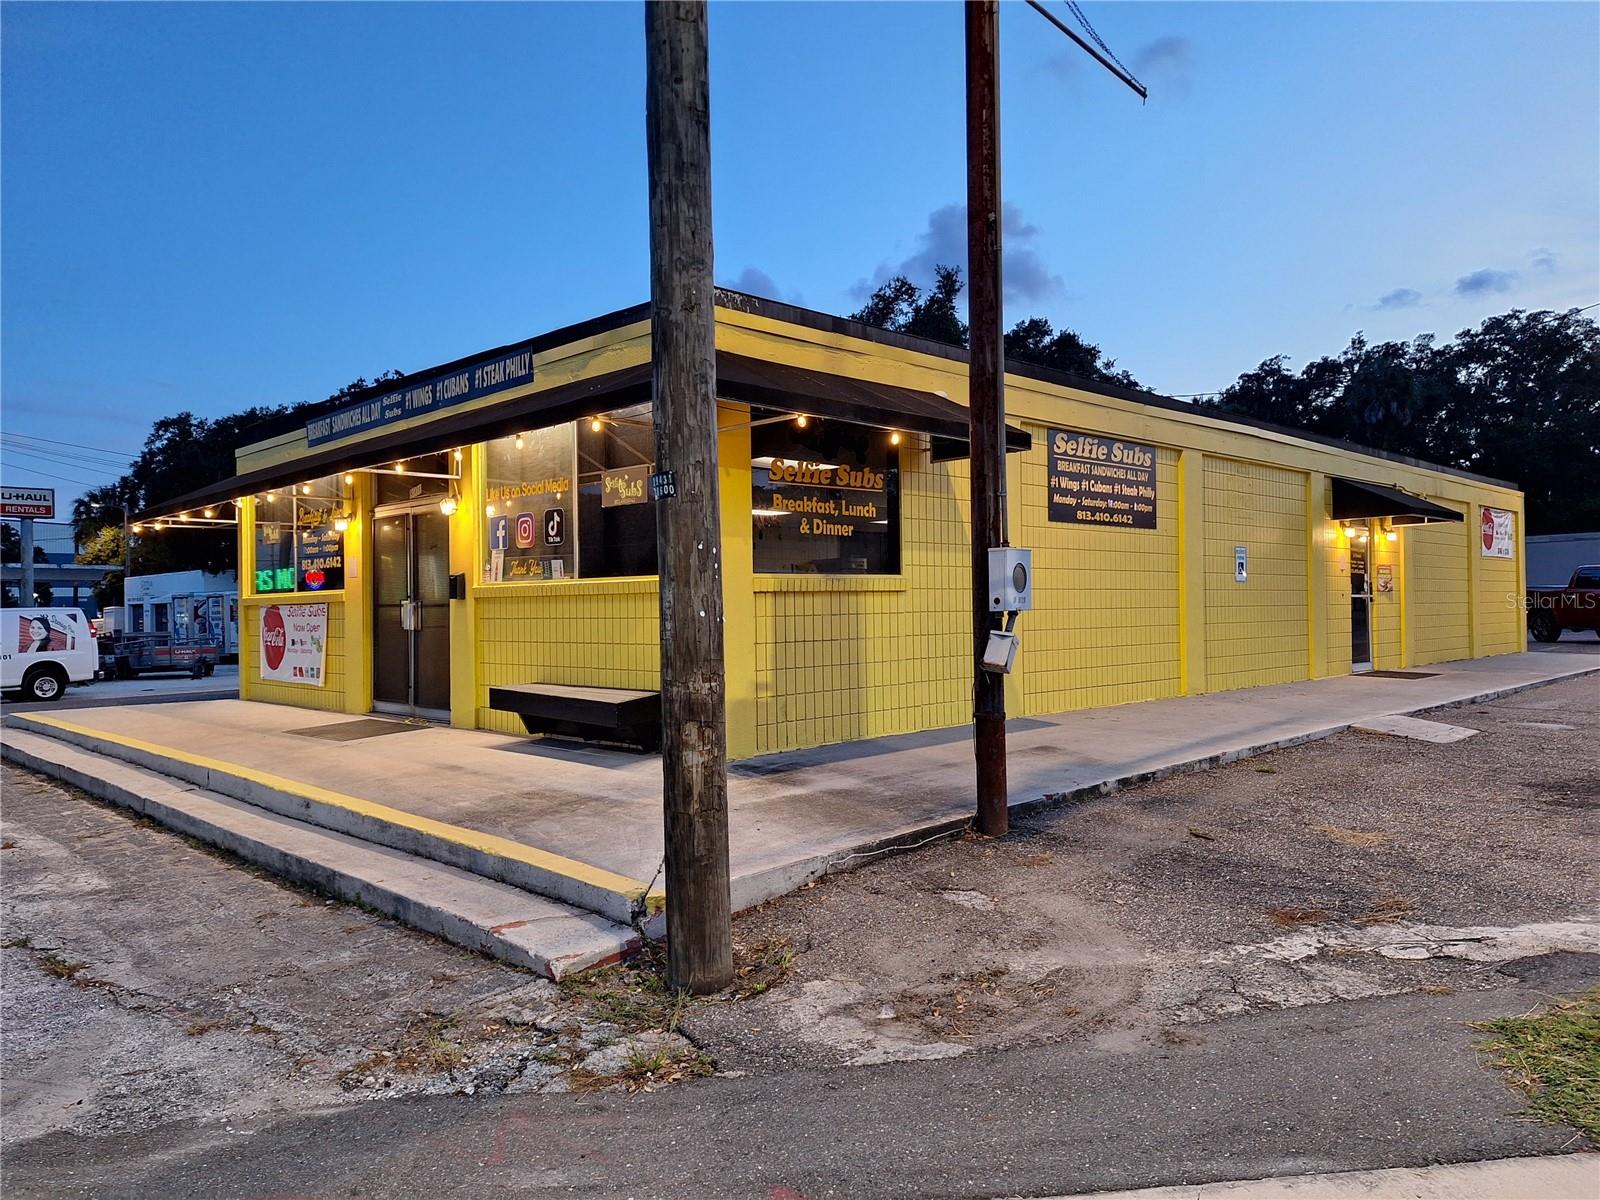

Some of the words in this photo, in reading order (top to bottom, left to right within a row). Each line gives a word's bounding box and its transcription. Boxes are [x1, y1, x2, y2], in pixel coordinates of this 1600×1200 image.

[405, 389, 412, 410] #1
[411, 385, 432, 409] WINGS
[436, 382, 443, 401] #1
[443, 373, 469, 399] CUBANS
[475, 367, 482, 389] #1
[483, 361, 504, 387] STEAK
[505, 352, 530, 380] PHILLY
[382, 393, 402, 407] Selfie
[308, 418, 331, 440] BREAKFAST
[331, 408, 361, 433] SANDWICHES
[361, 404, 370, 424] ALL
[370, 401, 381, 421] DAY
[384, 407, 402, 419] Subs
[1053, 432, 1108, 460] Selfie
[1111, 442, 1152, 467] Subs
[769, 458, 832, 485] Selfie
[836, 464, 884, 489] Subs
[1057, 460, 1090, 475] BREAKFAST
[1091, 464, 1126, 479] SANDWICHES
[1127, 469, 1137, 481] ALL
[1137, 471, 1149, 482] DAY
[1, 492, 50, 502] U-HAUL
[486, 488, 500, 502] Like
[500, 486, 510, 499] Us
[521, 480, 544, 497] Social
[545, 477, 569, 493] Media
[1050, 475, 1059, 488] #1
[1060, 476, 1080, 492] Wings
[1081, 479, 1089, 491] #1
[1089, 479, 1112, 494] Cubans
[1113, 482, 1121, 495] #1
[1121, 484, 1138, 496] Steak
[1138, 485, 1155, 500] Philly
[6, 505, 46, 513] RENTALS
[772, 493, 839, 517] Breakfast,
[842, 500, 877, 518] Lunch
[1053, 493, 1077, 507] Monday
[1076, 510, 1133, 524] 813.410.6142
[800, 518, 810, 534] &
[813, 519, 854, 537] Dinner
[307, 605, 326, 617] Subs
